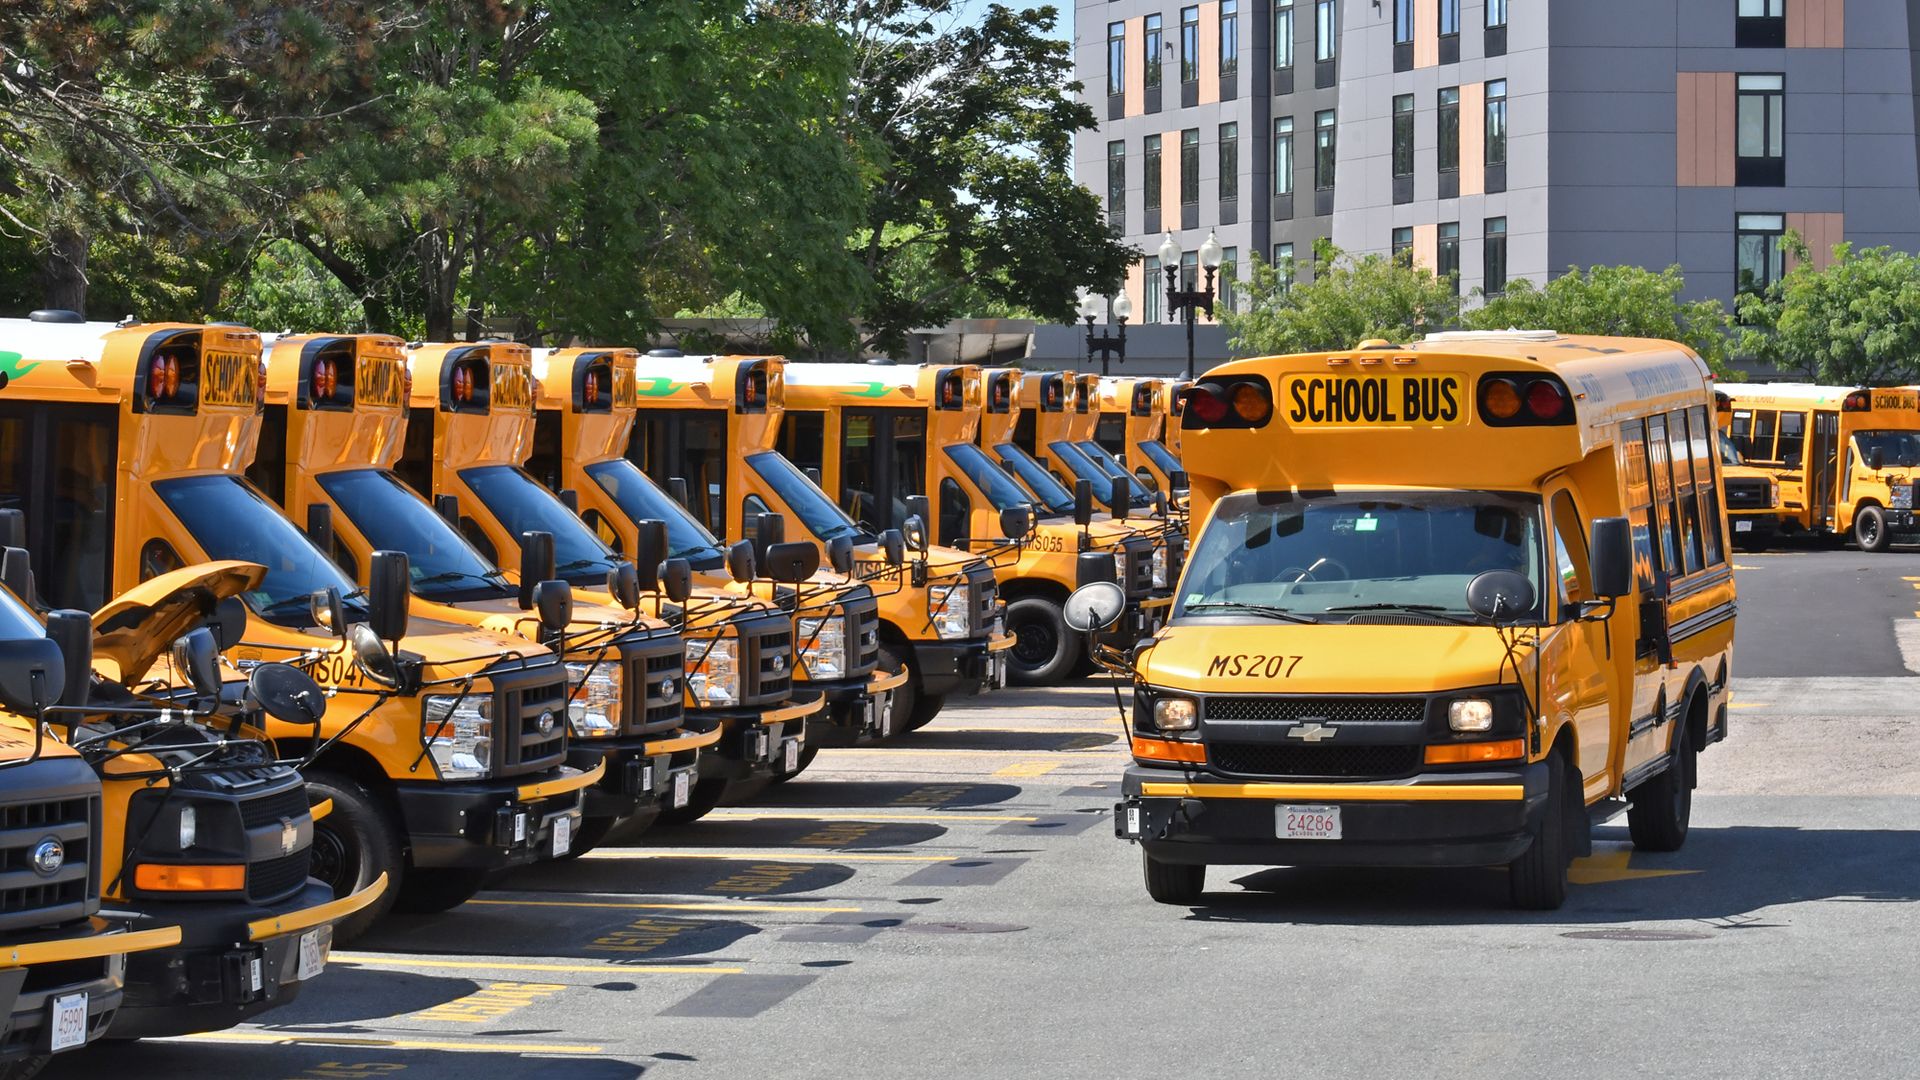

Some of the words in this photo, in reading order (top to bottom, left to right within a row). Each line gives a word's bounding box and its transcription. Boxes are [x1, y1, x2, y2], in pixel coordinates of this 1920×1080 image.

[1290, 378, 1396, 422] SCHOOL
[1403, 377, 1458, 422] BUS
[1874, 395, 1902, 410] SCHOOL
[1207, 654, 1303, 678] MS207
[1287, 814, 1333, 831] 24286
[59, 1008, 84, 1034] 45990
